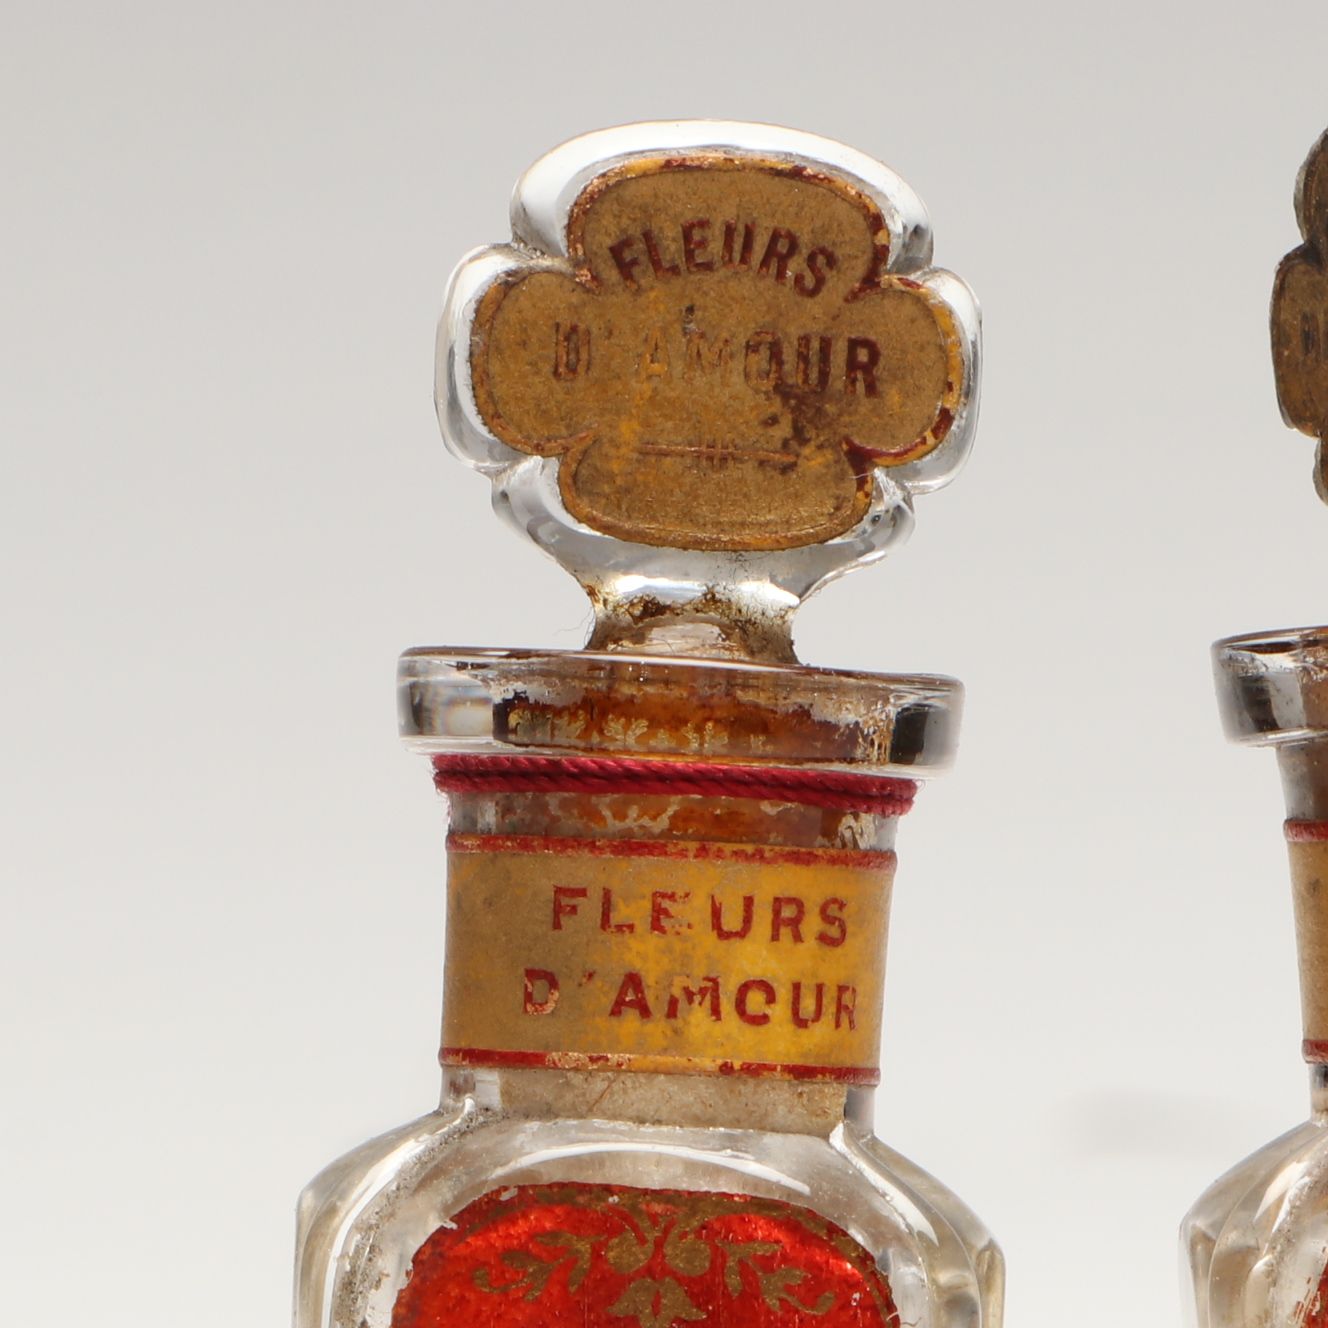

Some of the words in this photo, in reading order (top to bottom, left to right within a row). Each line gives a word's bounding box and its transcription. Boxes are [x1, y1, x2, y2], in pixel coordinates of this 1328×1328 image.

[608, 216, 838, 300] FLEURS
[552, 884, 848, 949] FLEURS
[522, 968, 858, 1032] D'AMOUR
